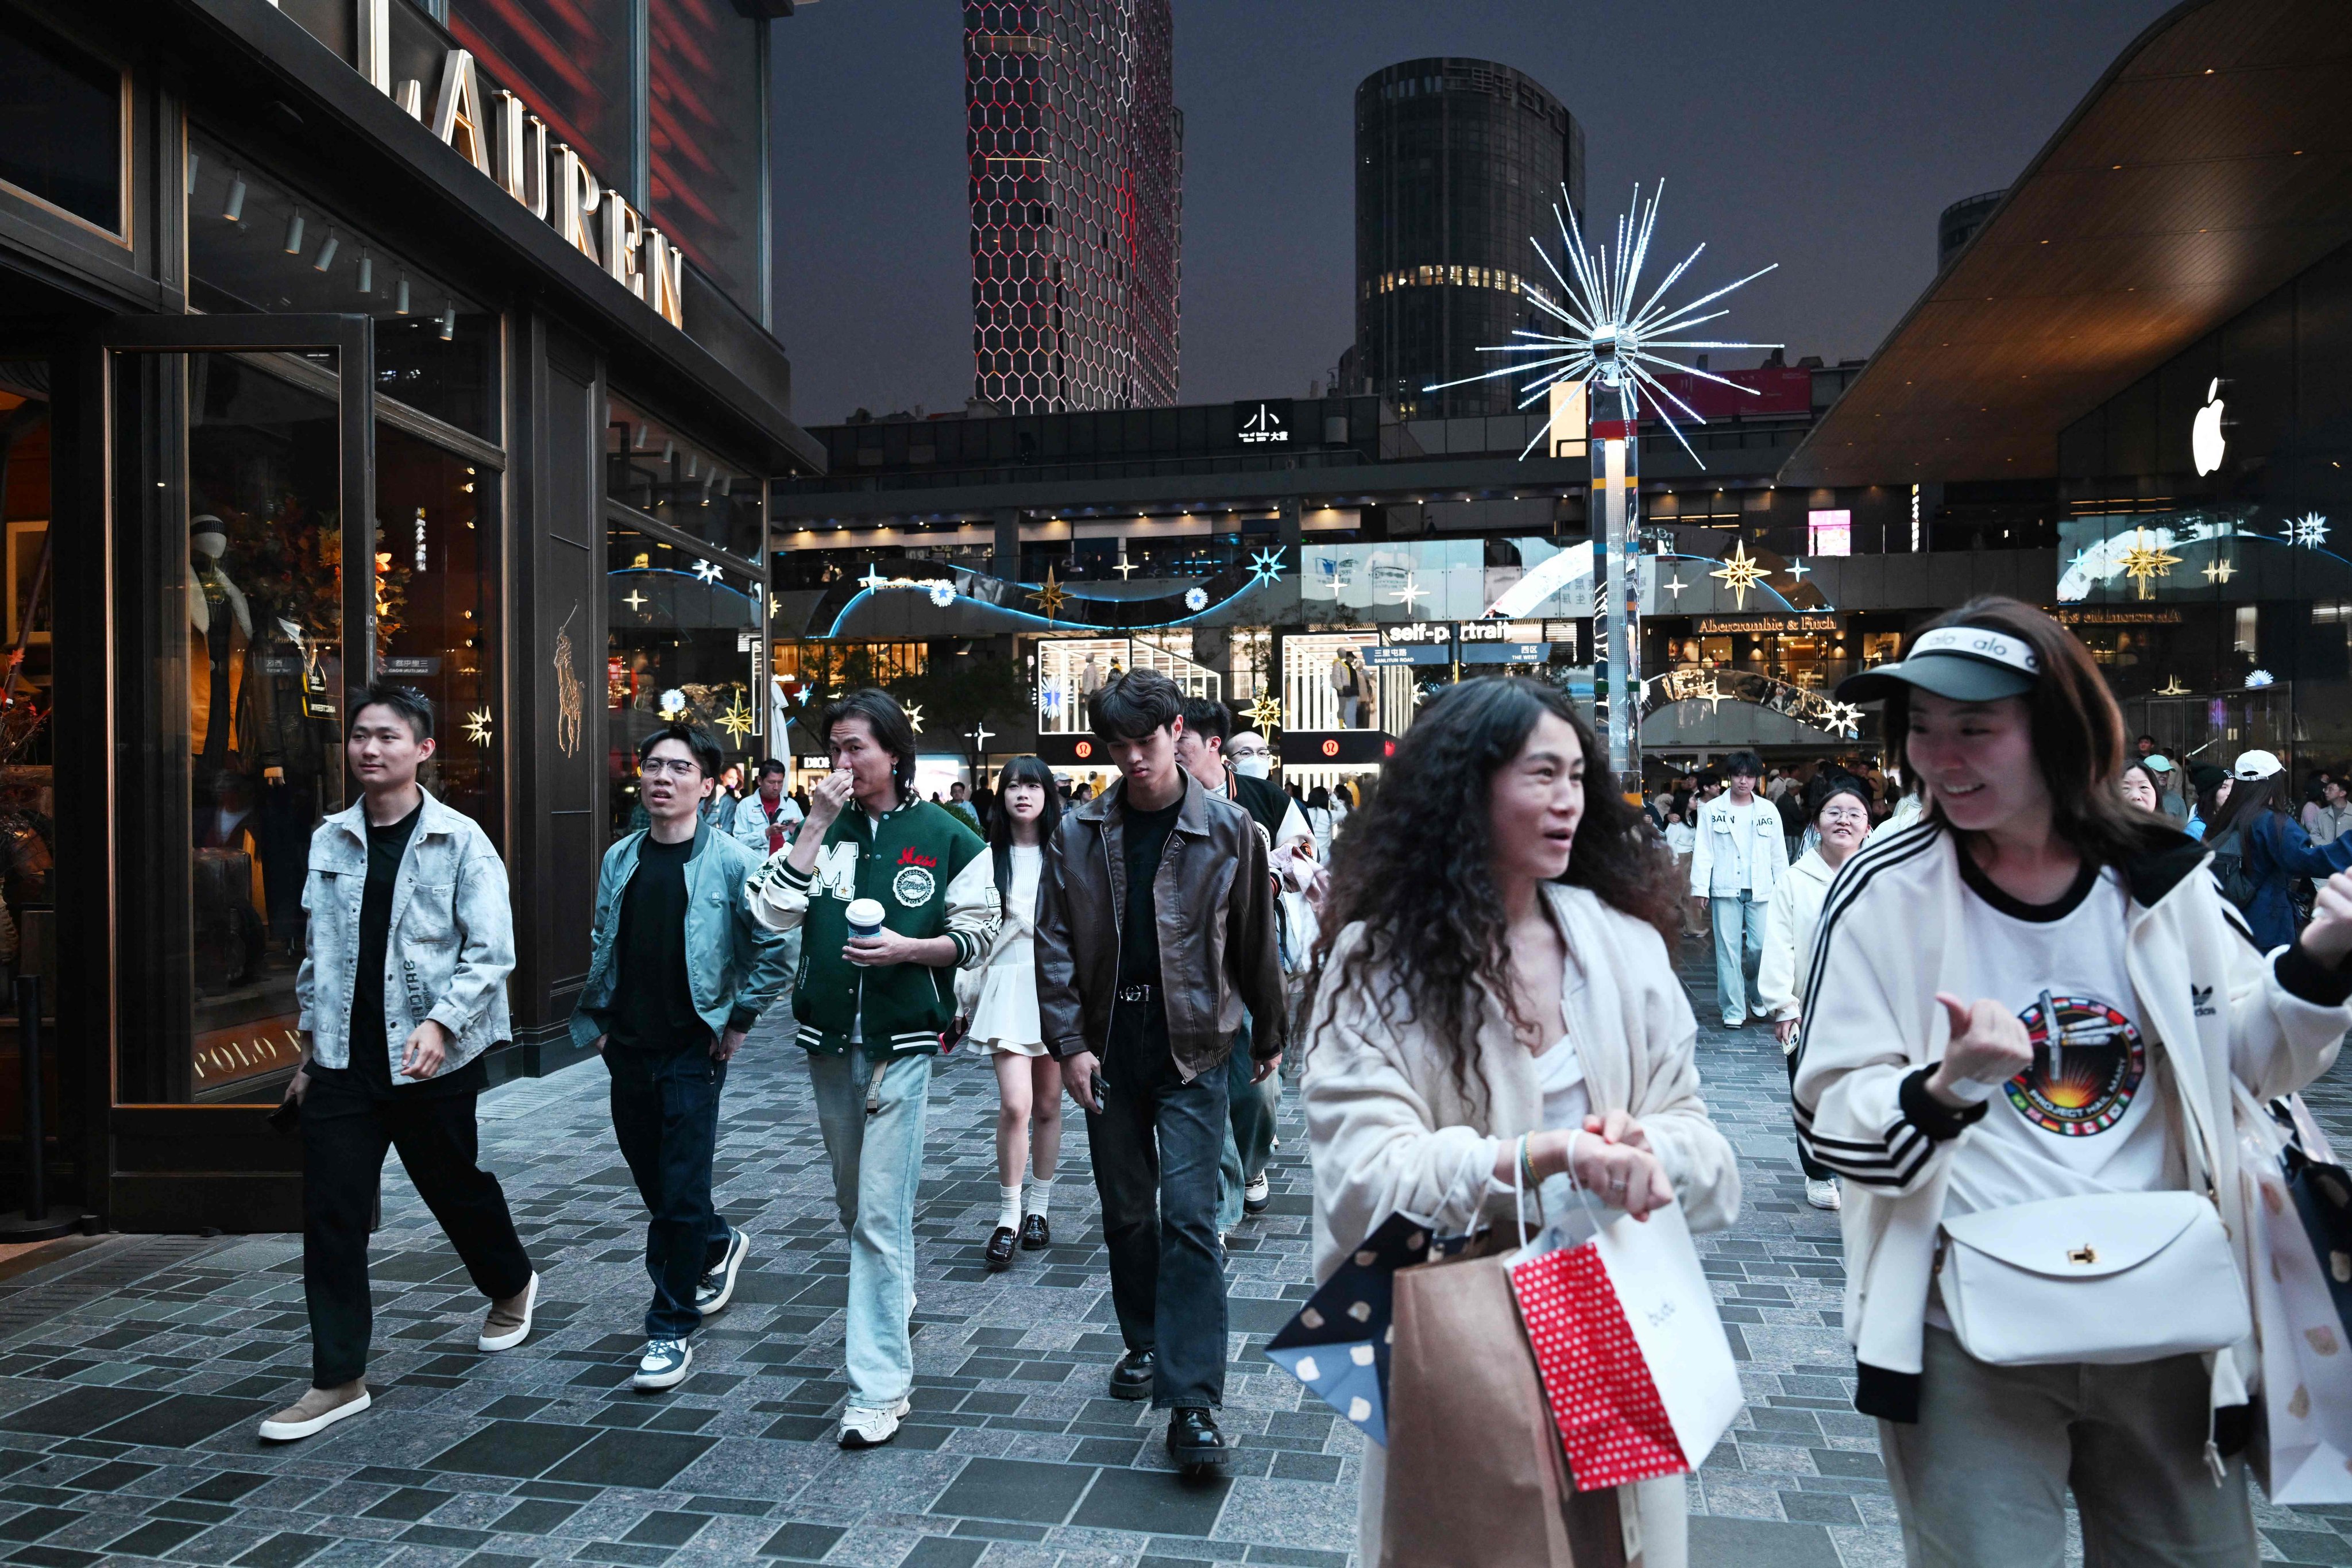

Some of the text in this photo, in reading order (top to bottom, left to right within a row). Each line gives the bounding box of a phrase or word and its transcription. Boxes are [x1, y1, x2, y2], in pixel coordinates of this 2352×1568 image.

[357, 0, 683, 329] LAUREN
[1243, 404, 1280, 431] 小
[1389, 621, 1511, 644] self-prtrait
[1698, 616, 1837, 632] Abercrombie & Fitch
[1374, 648, 1407, 656] 三里屯路
[1520, 645, 1538, 654] 西区
[1973, 637, 2007, 655] alo
[808, 841, 859, 902] M
[195, 1036, 277, 1079] POLO
